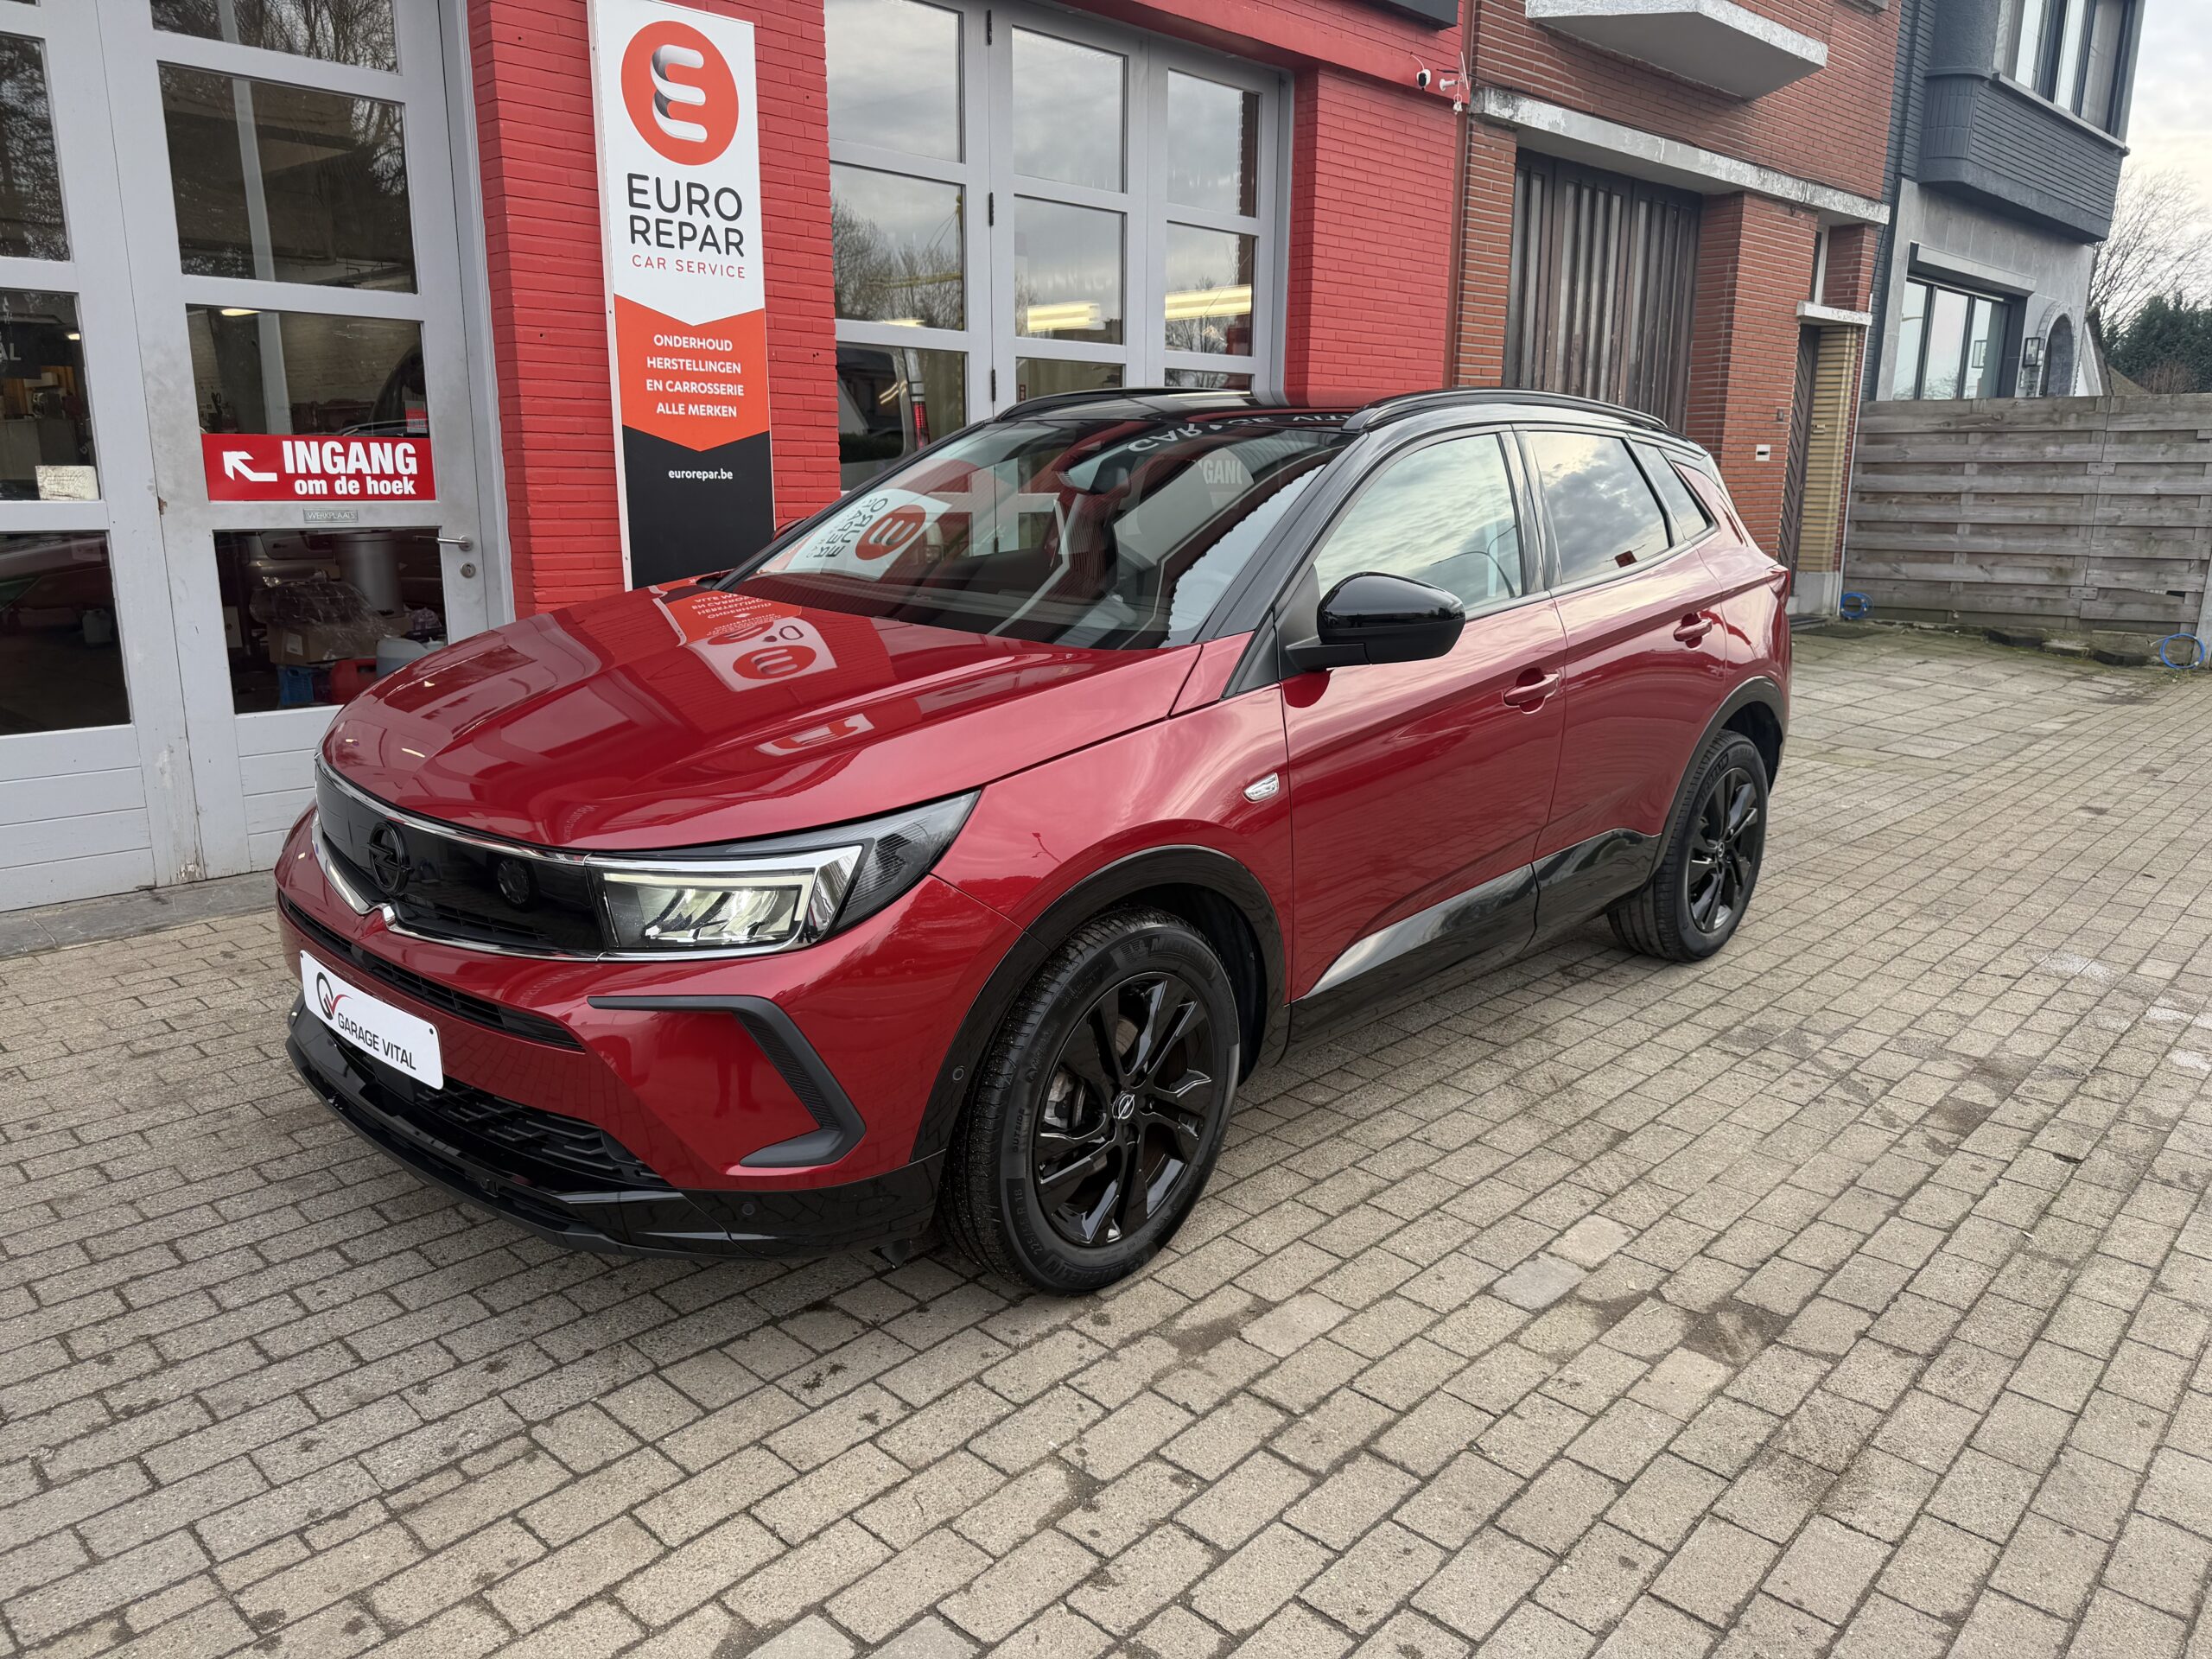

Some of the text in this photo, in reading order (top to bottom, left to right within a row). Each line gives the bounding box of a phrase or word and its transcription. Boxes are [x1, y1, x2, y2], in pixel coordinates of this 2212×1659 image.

[626, 172, 742, 221] EURO
[629, 214, 744, 257] REPAR
[632, 254, 746, 278] CAR SERVICE
[653, 334, 733, 352] ONDERHOUD
[646, 356, 741, 374] HERSTELLINGEN
[645, 379, 744, 396] EN CARROSSERIE
[656, 403, 737, 417] ALLE MERKEN
[282, 441, 418, 474] INGANG
[668, 468, 733, 481] eurorepar.be
[294, 476, 416, 495] om de hoek
[307, 511, 355, 519] WERKPLAATS
[338, 1012, 416, 1071] GARAGE VITAL
